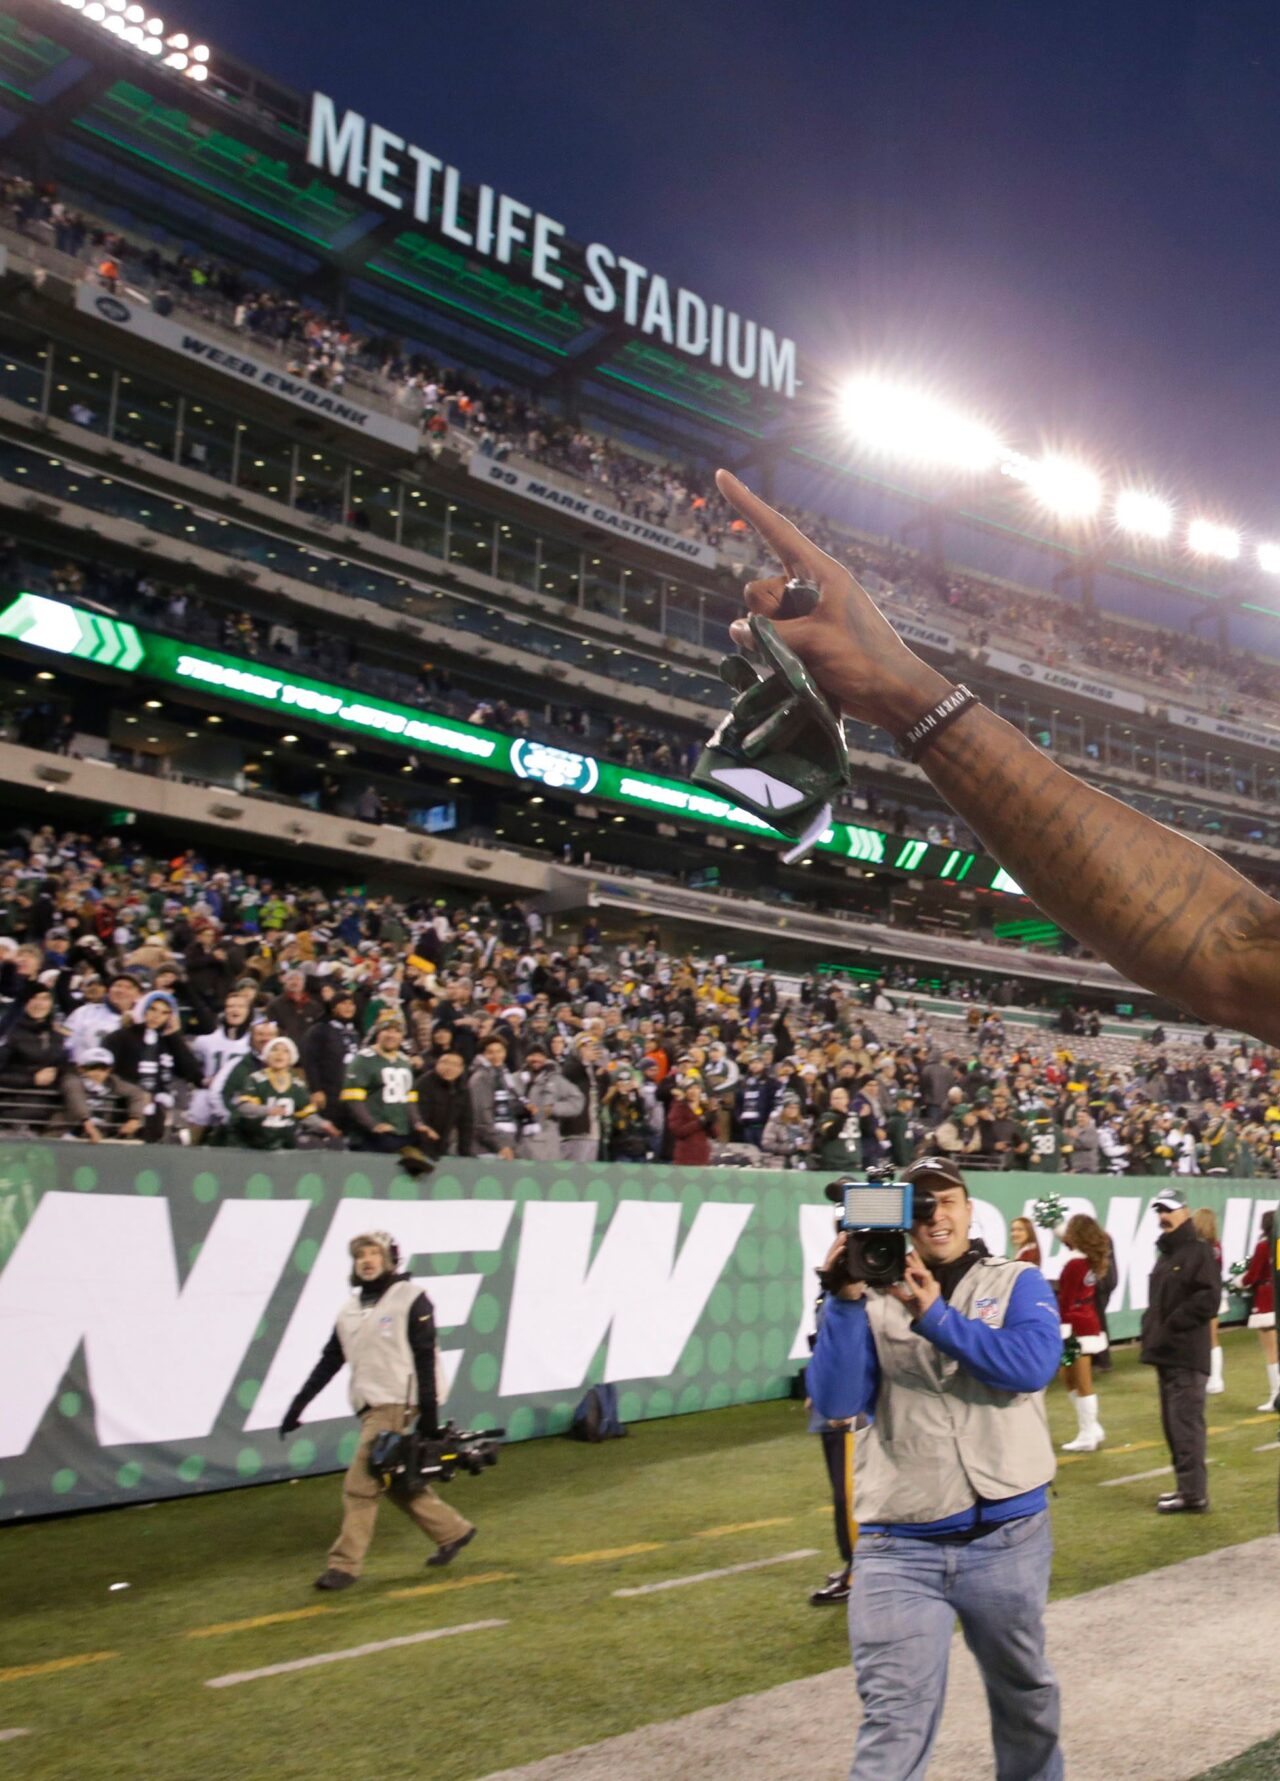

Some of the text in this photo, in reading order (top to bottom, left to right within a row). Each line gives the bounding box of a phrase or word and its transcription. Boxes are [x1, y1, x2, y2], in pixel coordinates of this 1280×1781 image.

[307, 91, 797, 398] METLIFE STADIUM
[182, 336, 258, 379] WEEB
[527, 482, 590, 515] MARK
[593, 509, 700, 557] GASTINEAU
[381, 1066, 413, 1104] 80
[0, 1191, 755, 1458] NEW
